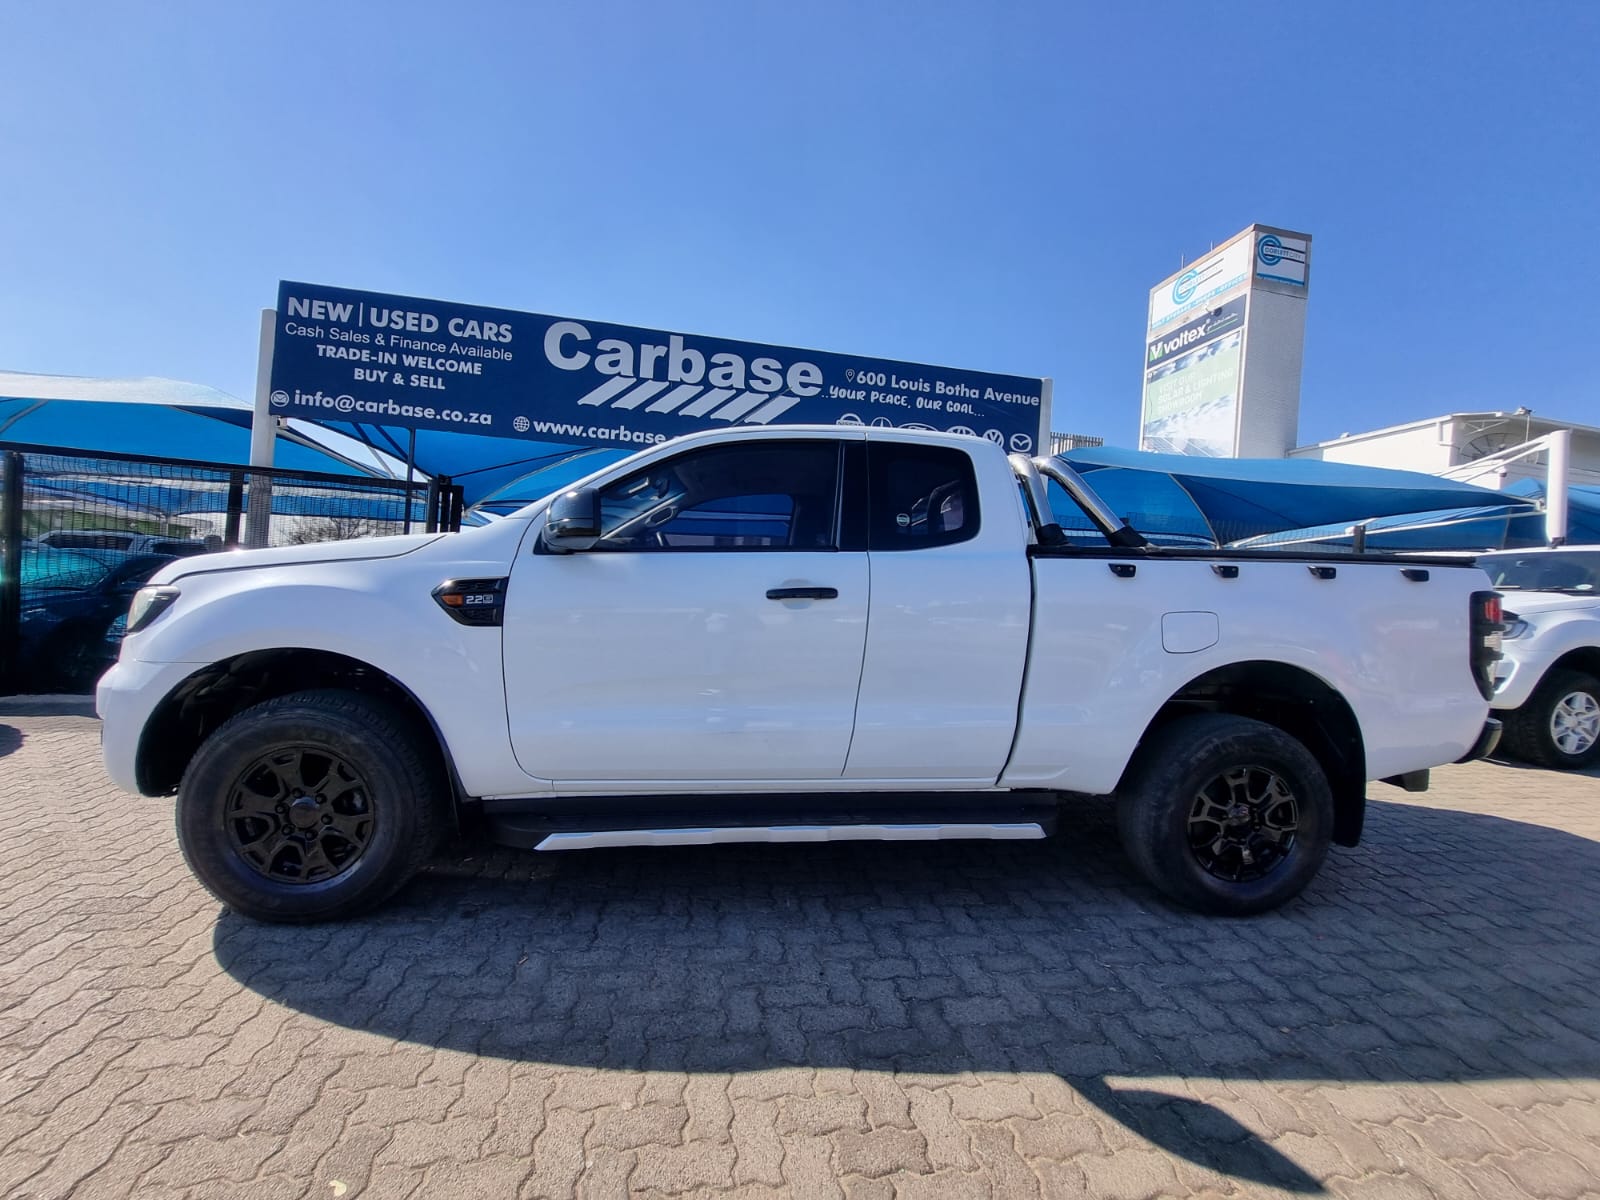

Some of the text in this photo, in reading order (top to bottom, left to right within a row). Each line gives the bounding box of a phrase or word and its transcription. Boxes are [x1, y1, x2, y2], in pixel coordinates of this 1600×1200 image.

[288, 297, 513, 343] NEW USED CARS
[285, 322, 513, 361] Cash Sales & Finance Available
[1164, 323, 1207, 354] voltex
[316, 344, 482, 375] TRADE-IN WELCOME
[544, 321, 823, 396] Carbase
[353, 368, 446, 390] BUY & SELL
[857, 371, 1039, 406] 600 Louis Botha Avenue
[294, 389, 492, 425] info@carbase.co.za
[916, 397, 942, 411] OUR
